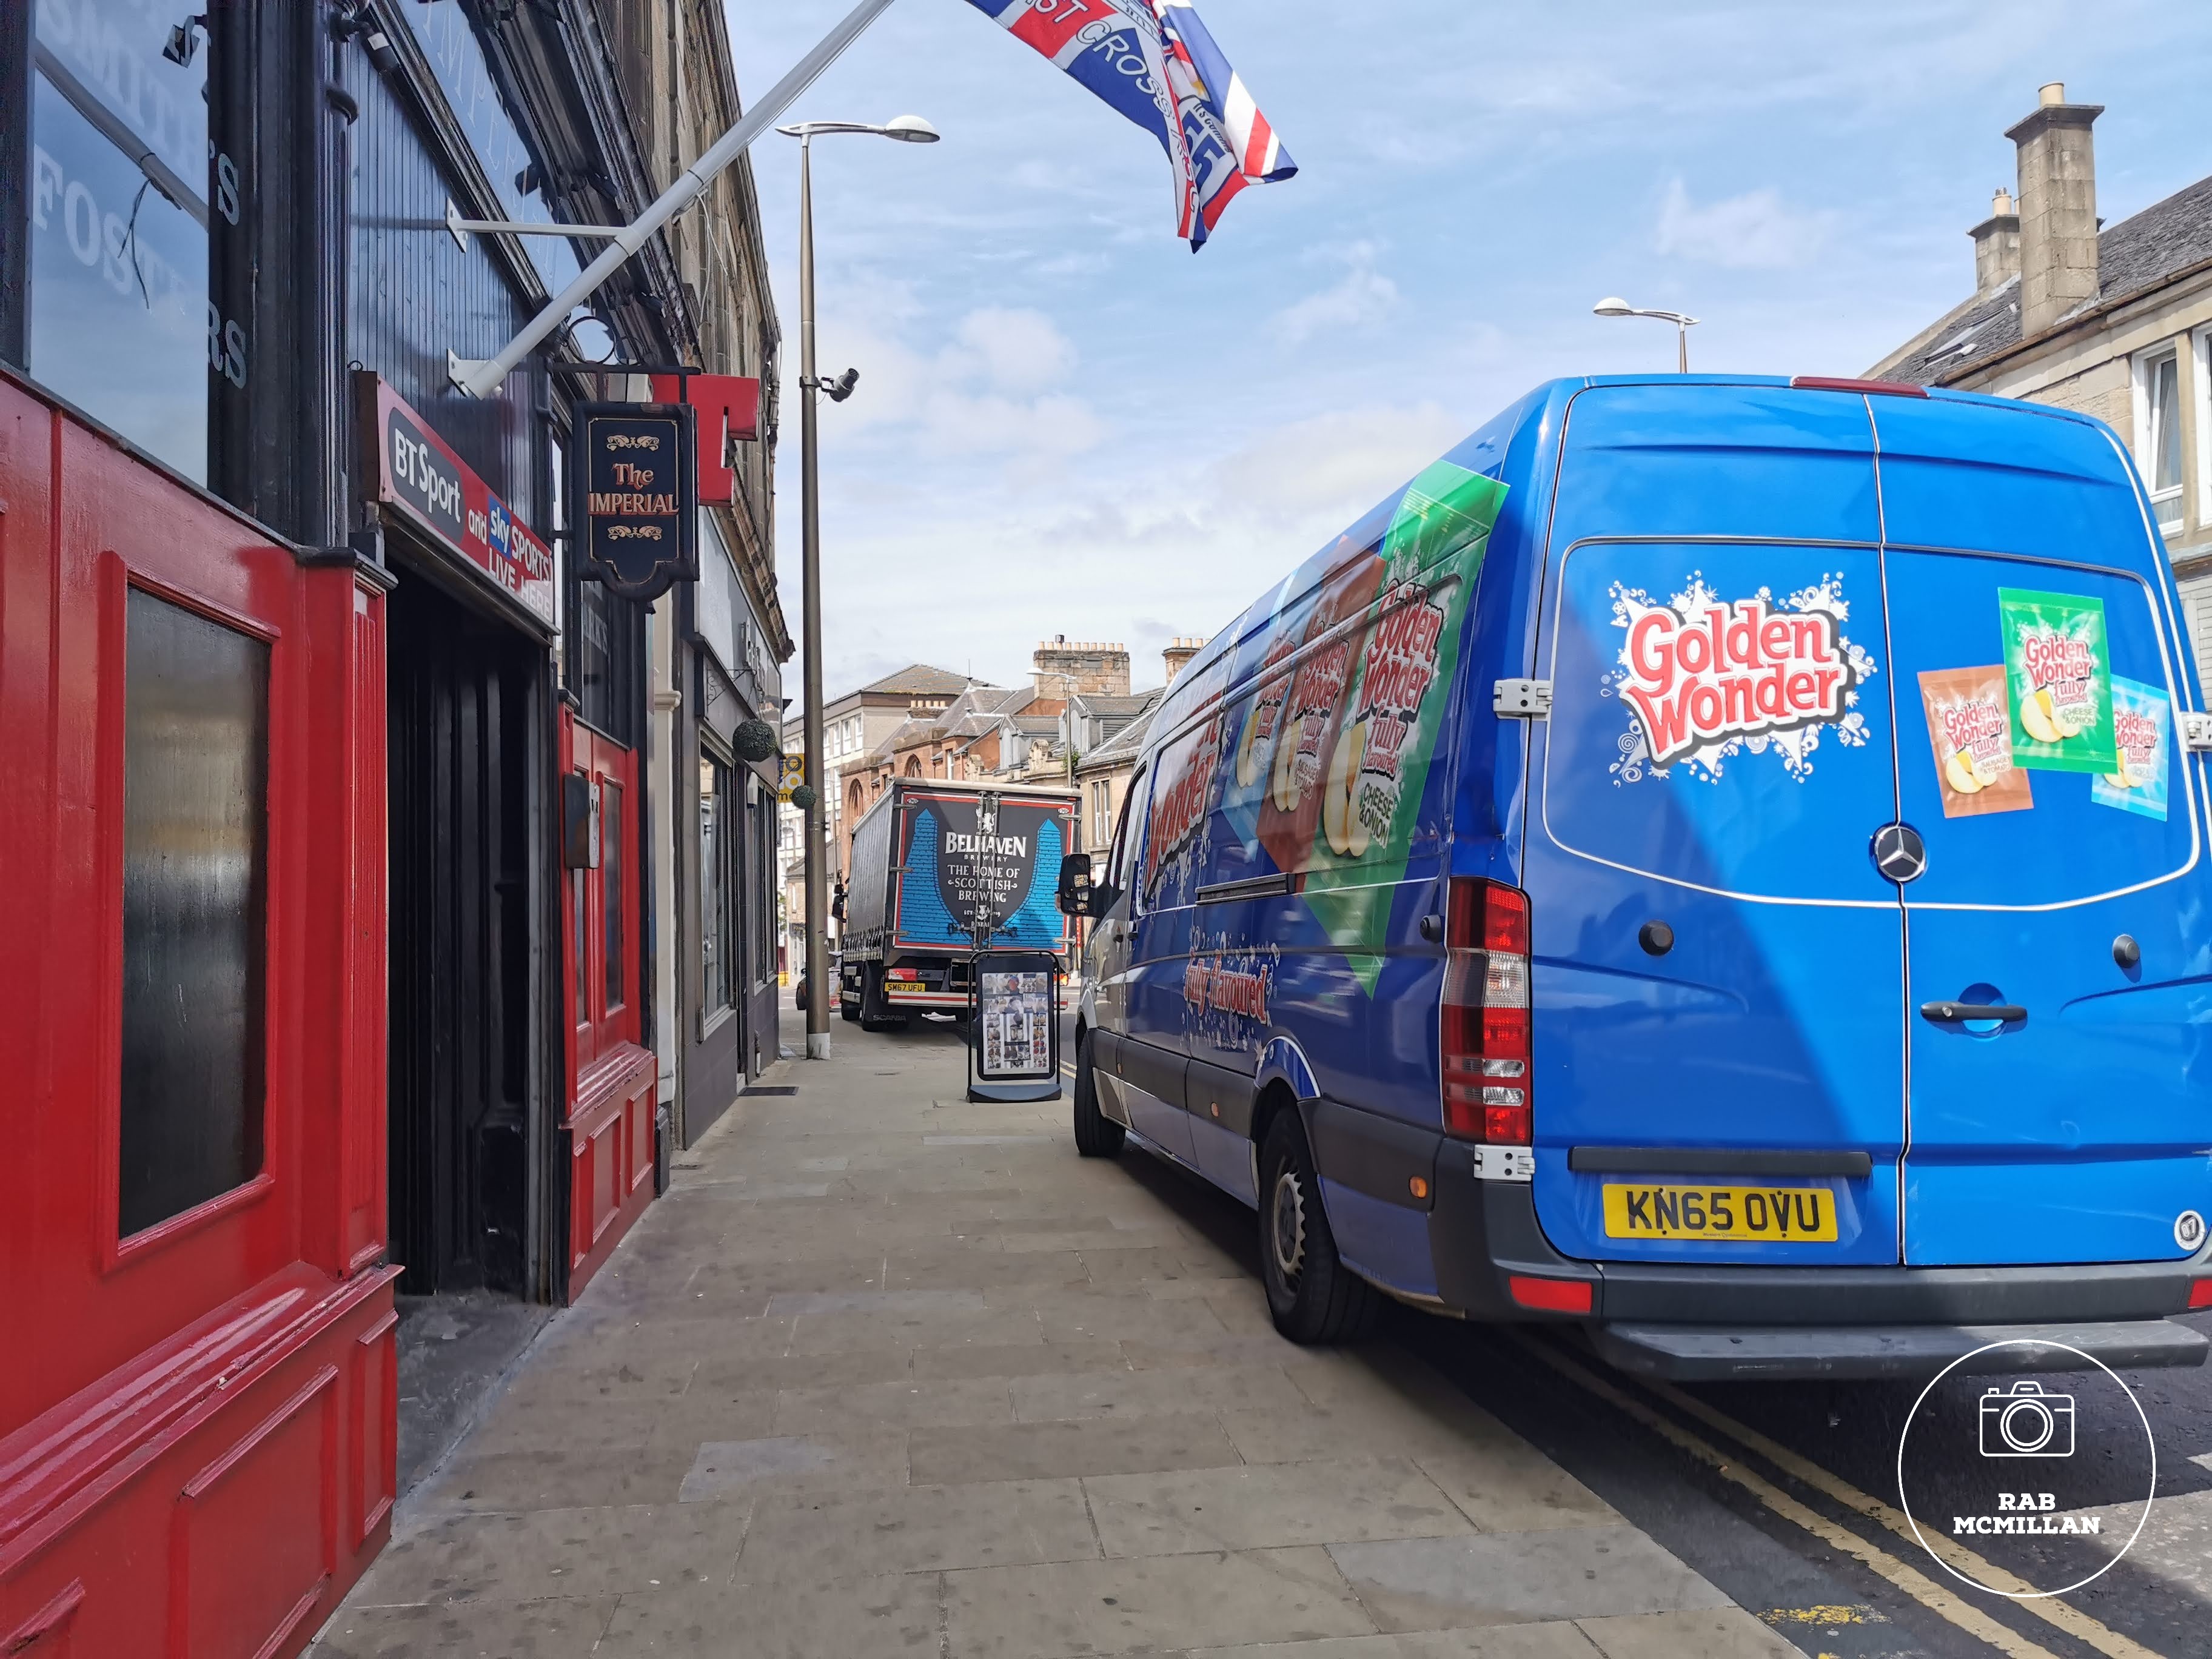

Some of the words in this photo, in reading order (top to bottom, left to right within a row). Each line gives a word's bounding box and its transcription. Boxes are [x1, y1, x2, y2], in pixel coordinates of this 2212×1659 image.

[1076, 19, 1175, 120] CROSS
[33, 143, 247, 389] FOSTRS
[395, 428, 417, 487] BT
[419, 443, 461, 524] Sport
[611, 462, 654, 491] The
[588, 492, 680, 516] IMPERIAL
[468, 508, 487, 546] and
[490, 506, 510, 554] sky
[511, 525, 550, 585] SPORTS
[489, 548, 516, 592] LIVE
[521, 575, 551, 622] HERE
[1369, 583, 1441, 665] Golden
[1630, 606, 1834, 697] Golden
[2025, 637, 2088, 668] Golden
[1358, 648, 1431, 716] Wonder
[2025, 659, 2091, 689] Wonder
[2054, 680, 2085, 697] fully
[1627, 661, 1840, 756] Wonder
[1943, 705, 1996, 735] Golden
[2063, 708, 2093, 717] CHEESE
[1367, 705, 1405, 754] fully
[1945, 719, 2001, 751] Wonder
[1972, 737, 1997, 756] fully
[2128, 746, 2151, 758] fully
[1364, 782, 1393, 820] CHEESE
[945, 832, 1027, 857] BELHAVEN
[947, 865, 969, 876] THE
[973, 866, 1004, 877] HOME
[1006, 868, 1020, 878] OF
[954, 877, 1011, 890] SCOTTISH
[958, 890, 1007, 903] BREWNG
[1184, 946, 1211, 1017] fully
[1208, 950, 1268, 1025] flavoured
[1626, 1190, 1733, 1233] KN65
[1746, 1188, 1820, 1233] OVU
